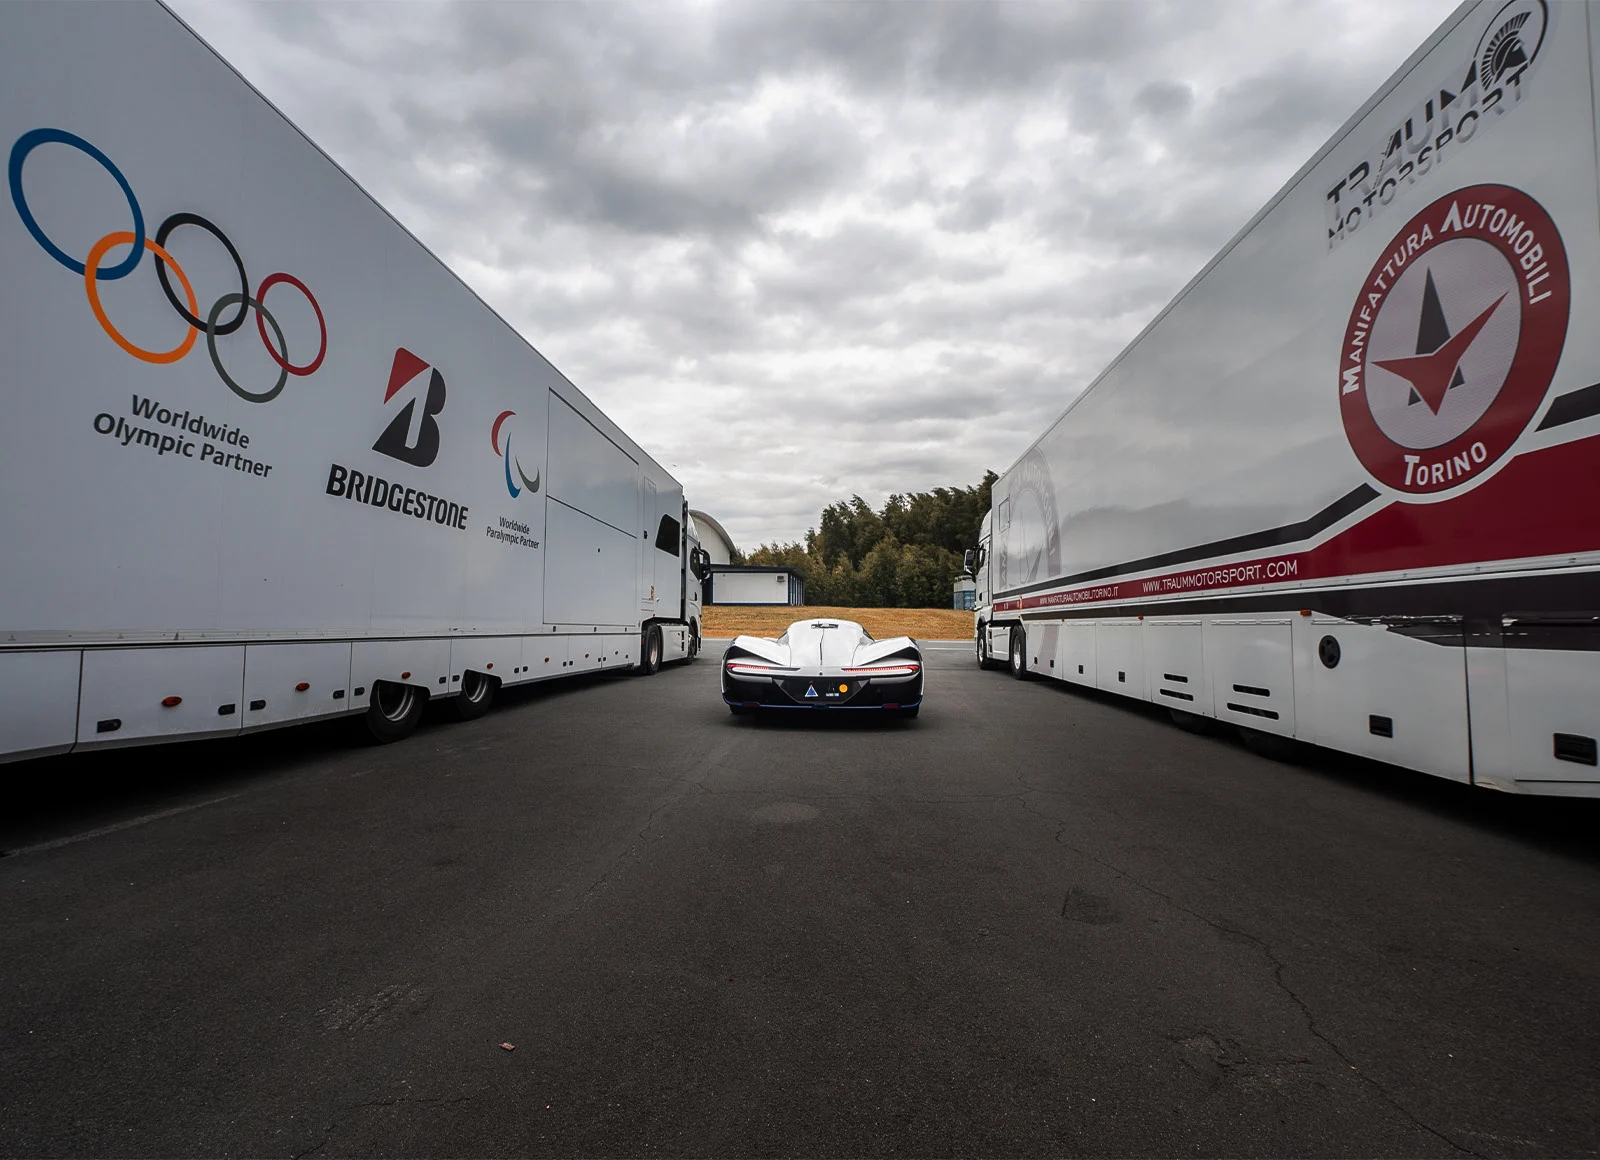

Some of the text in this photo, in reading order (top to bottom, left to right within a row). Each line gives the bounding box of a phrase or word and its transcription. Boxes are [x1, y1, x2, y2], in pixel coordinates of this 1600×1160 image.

[1326, 60, 1477, 222] TRAUM
[1328, 63, 1528, 250] MOTORSPORT
[1342, 200, 1552, 396] MANIFATTURA AUTOMOBILI
[93, 412, 273, 478] Olympic Partner
[131, 394, 250, 449] Worldwide
[1403, 441, 1488, 487] TORINO
[326, 463, 469, 531] BRIDGESTONE
[499, 516, 530, 535] Worldwide
[486, 525, 540, 549] Paralympic Partner
[1142, 559, 1298, 593] WWW.TRAUMMOTORSPORT.COM
